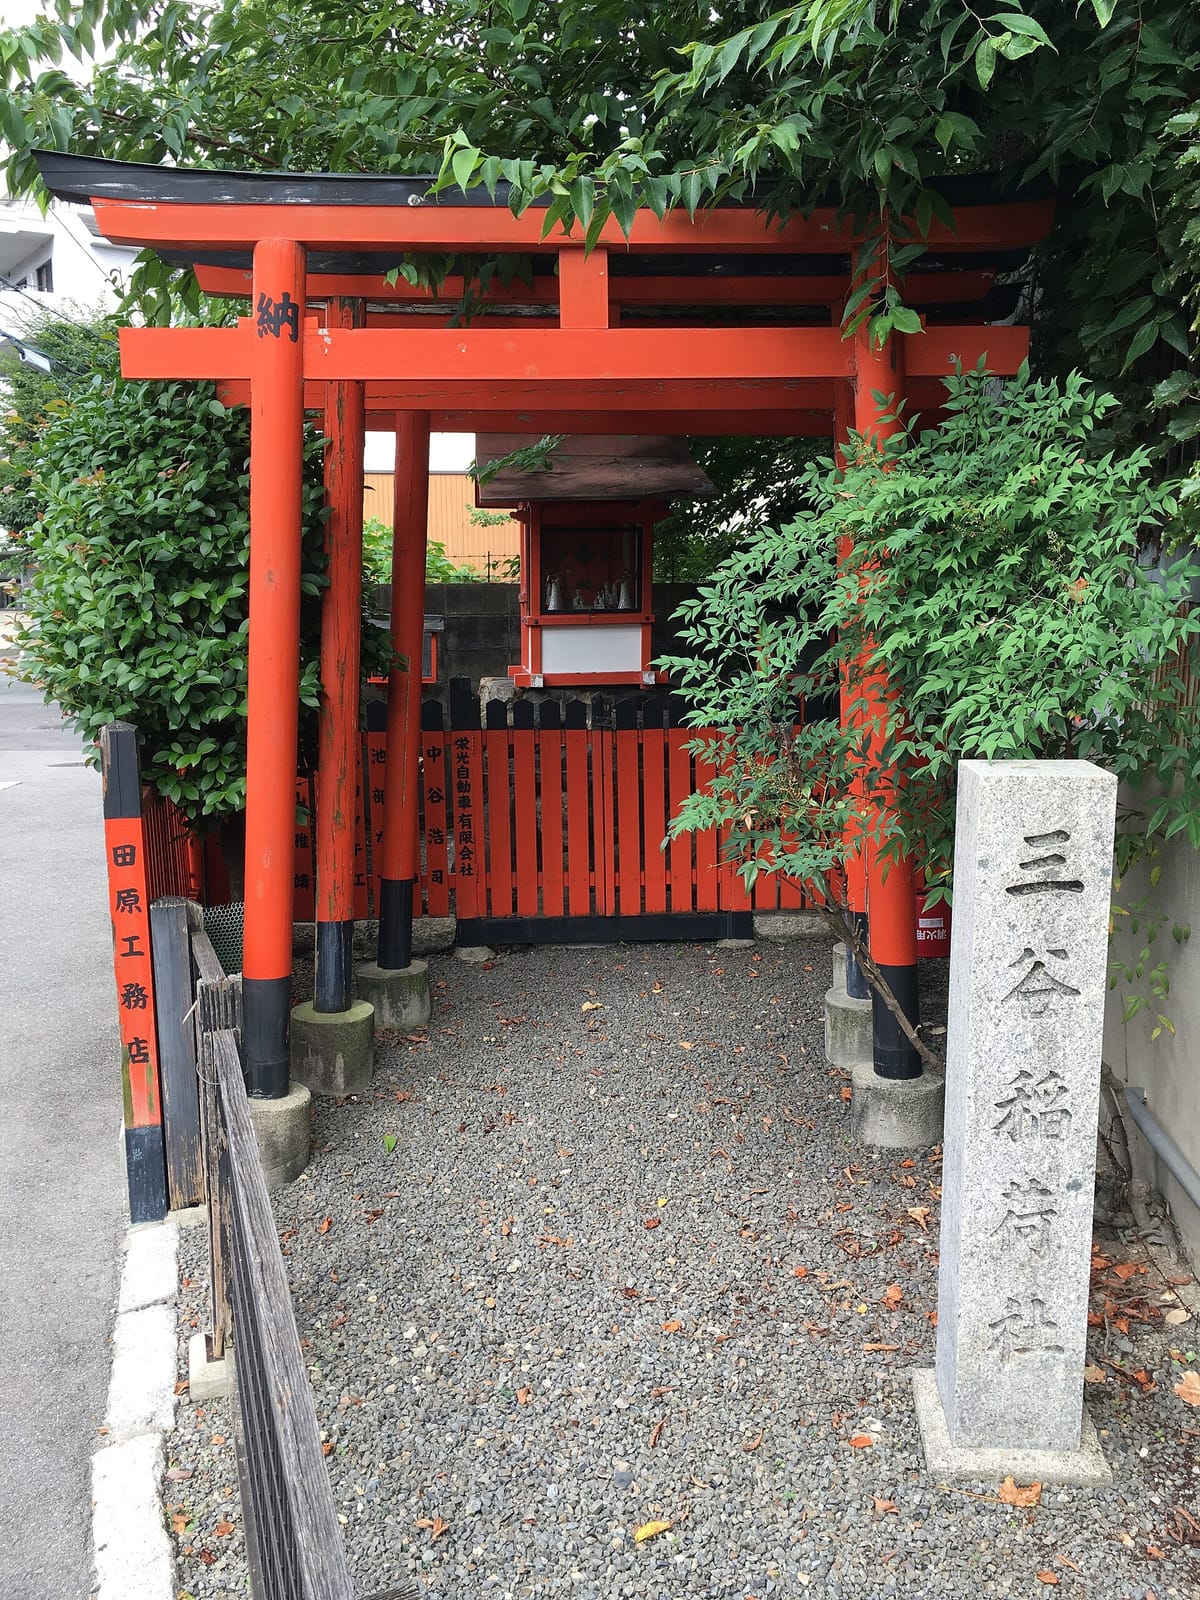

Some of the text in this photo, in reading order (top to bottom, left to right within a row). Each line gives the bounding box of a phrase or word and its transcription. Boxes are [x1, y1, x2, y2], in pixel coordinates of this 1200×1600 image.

[257, 292, 299, 343] 納
[426, 746, 445, 885] 中谷浩司
[454, 736, 475, 877] 栄光自動車有限会社
[112, 844, 151, 1066] 田原工務店
[916, 929, 947, 941] 消火用
[986, 829, 1085, 1365] 三谷稲荷社
